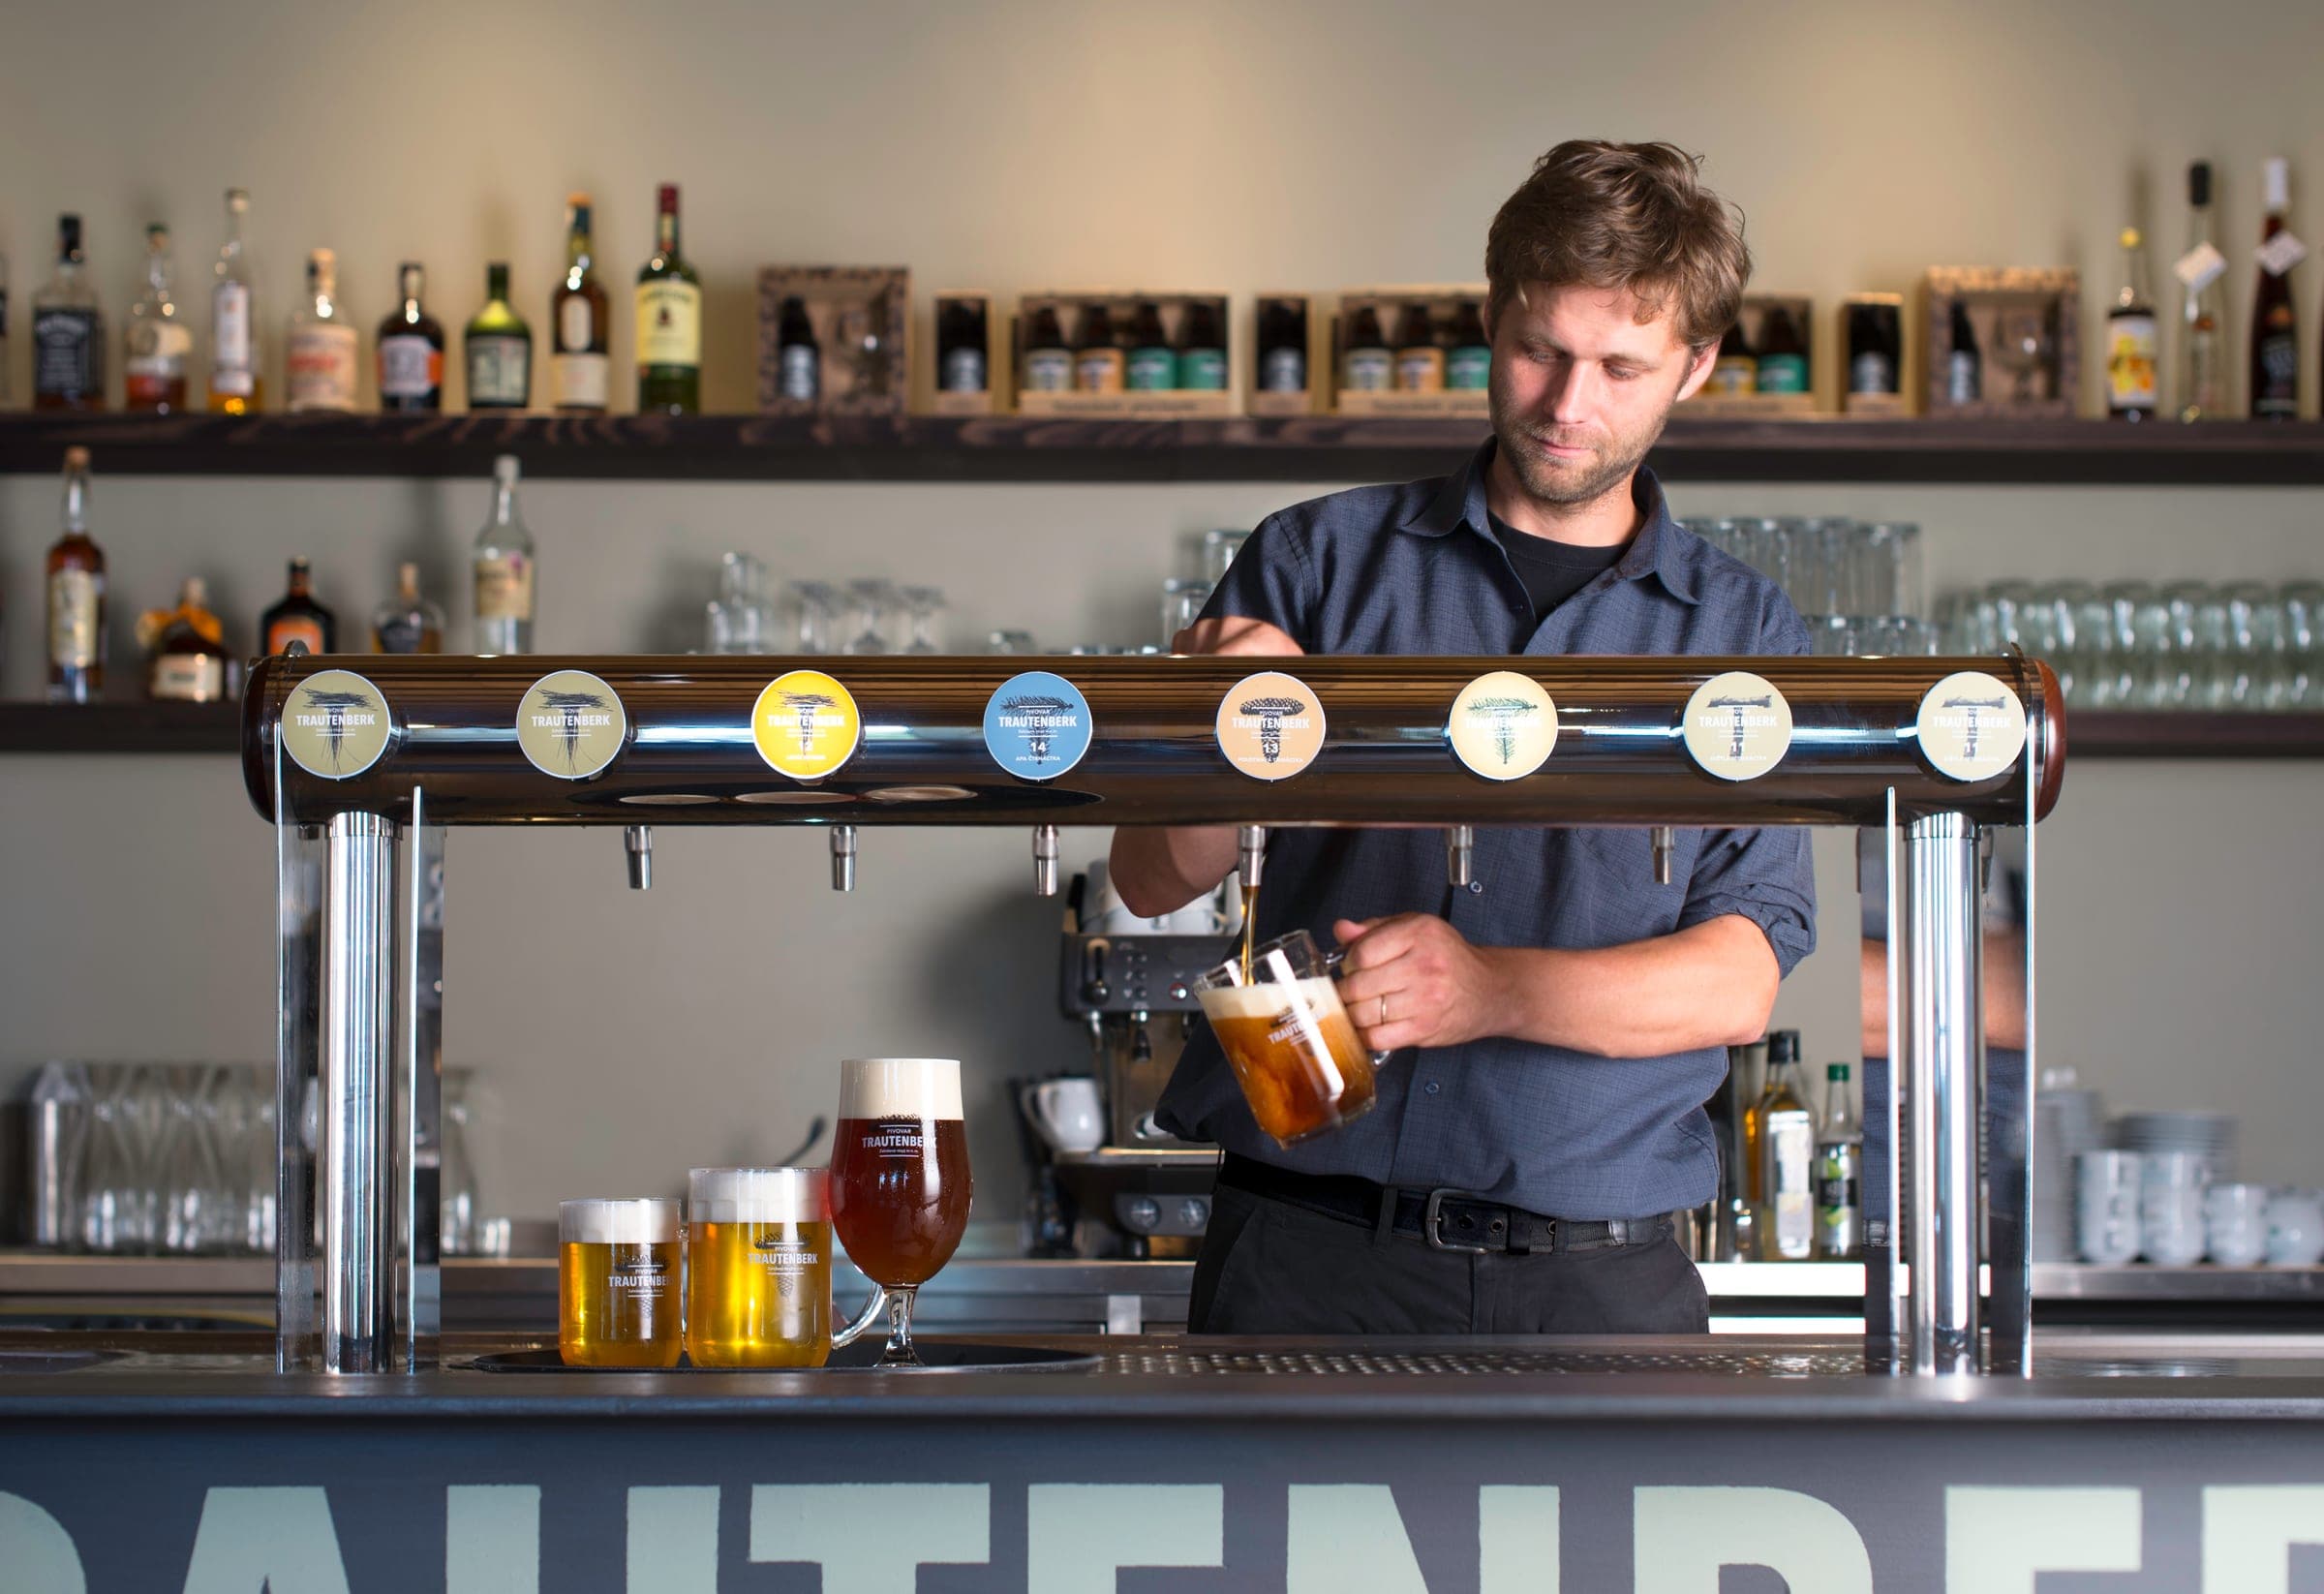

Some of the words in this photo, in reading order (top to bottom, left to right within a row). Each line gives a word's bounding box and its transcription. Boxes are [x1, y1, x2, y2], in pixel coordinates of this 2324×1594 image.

[295, 714, 375, 727] TRAUTENBERK
[531, 714, 611, 727] TRAUTENBERK
[998, 716, 1077, 727] TRAUTENBERK
[1231, 718, 1310, 729] TRAUTENBERK
[1698, 716, 1778, 728] TRAUTENBERK
[1030, 742, 1047, 752] 14
[1263, 743, 1278, 753] 13
[862, 1135, 937, 1148] TRAUTENBE
[748, 1253, 818, 1265] TRAUTENBERK
